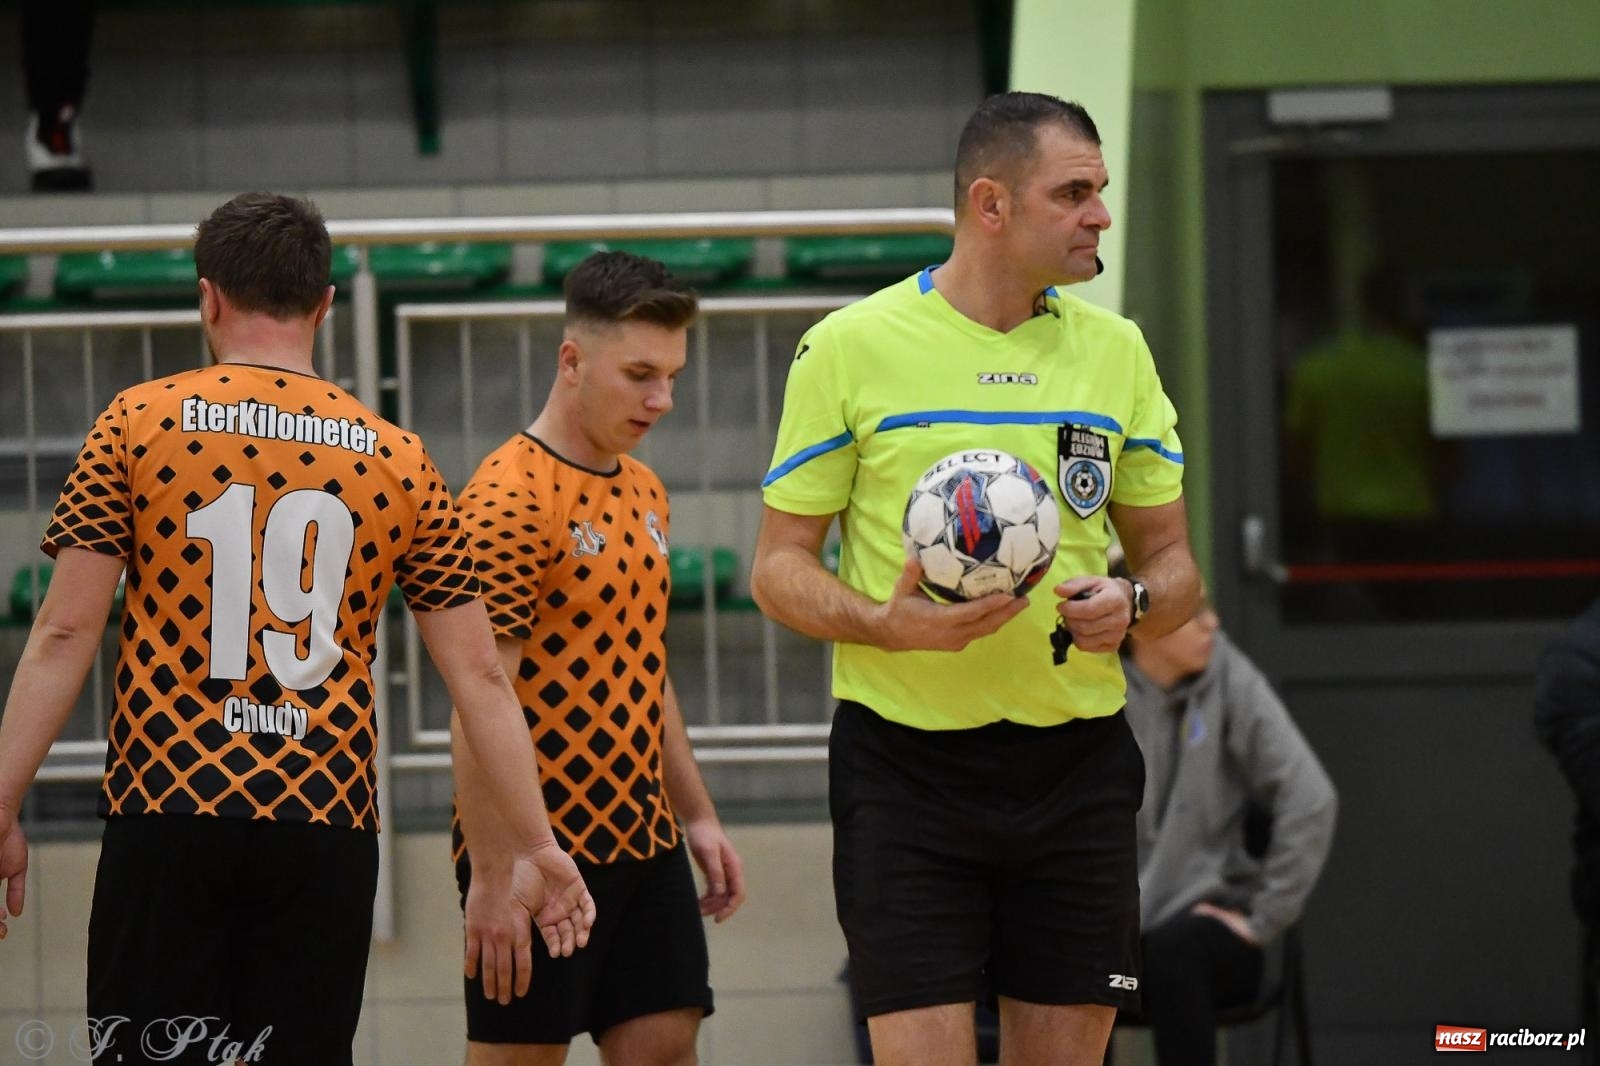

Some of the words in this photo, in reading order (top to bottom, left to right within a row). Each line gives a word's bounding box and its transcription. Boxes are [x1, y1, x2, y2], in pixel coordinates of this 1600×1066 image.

[182, 398, 378, 456] EterKilometer
[922, 452, 1001, 482] SELECT
[186, 483, 355, 690] 19
[223, 695, 308, 740] Chudy
